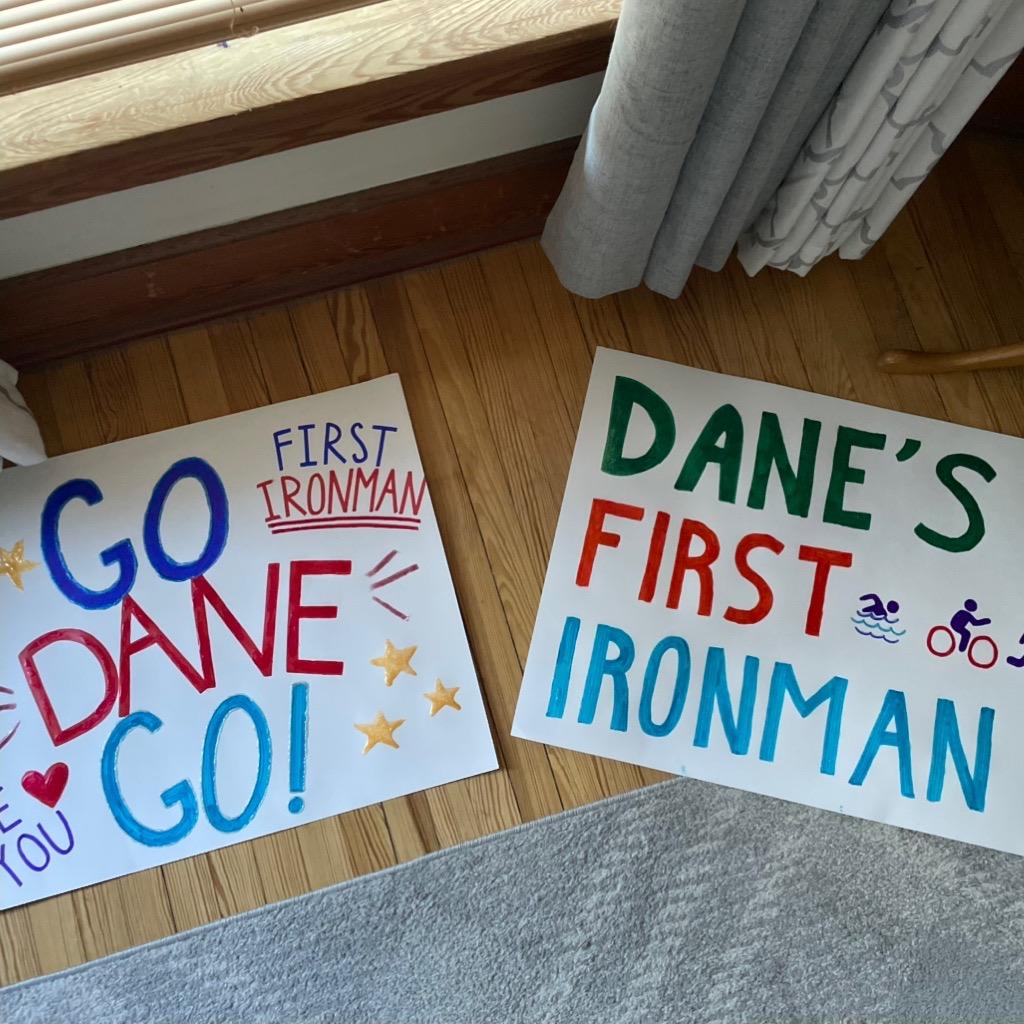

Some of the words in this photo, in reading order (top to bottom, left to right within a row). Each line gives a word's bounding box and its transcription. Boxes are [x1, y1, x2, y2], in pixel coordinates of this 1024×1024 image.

[256, 467, 428, 522] IRONMAN
[272, 421, 398, 471] FIRST
[600, 375, 997, 553] DANE'S
[40, 456, 229, 610] GO
[576, 497, 853, 637] FIRST
[18, 560, 352, 747] DANE
[545, 615, 996, 813] IRONMAN
[101, 682, 309, 848] GO!
